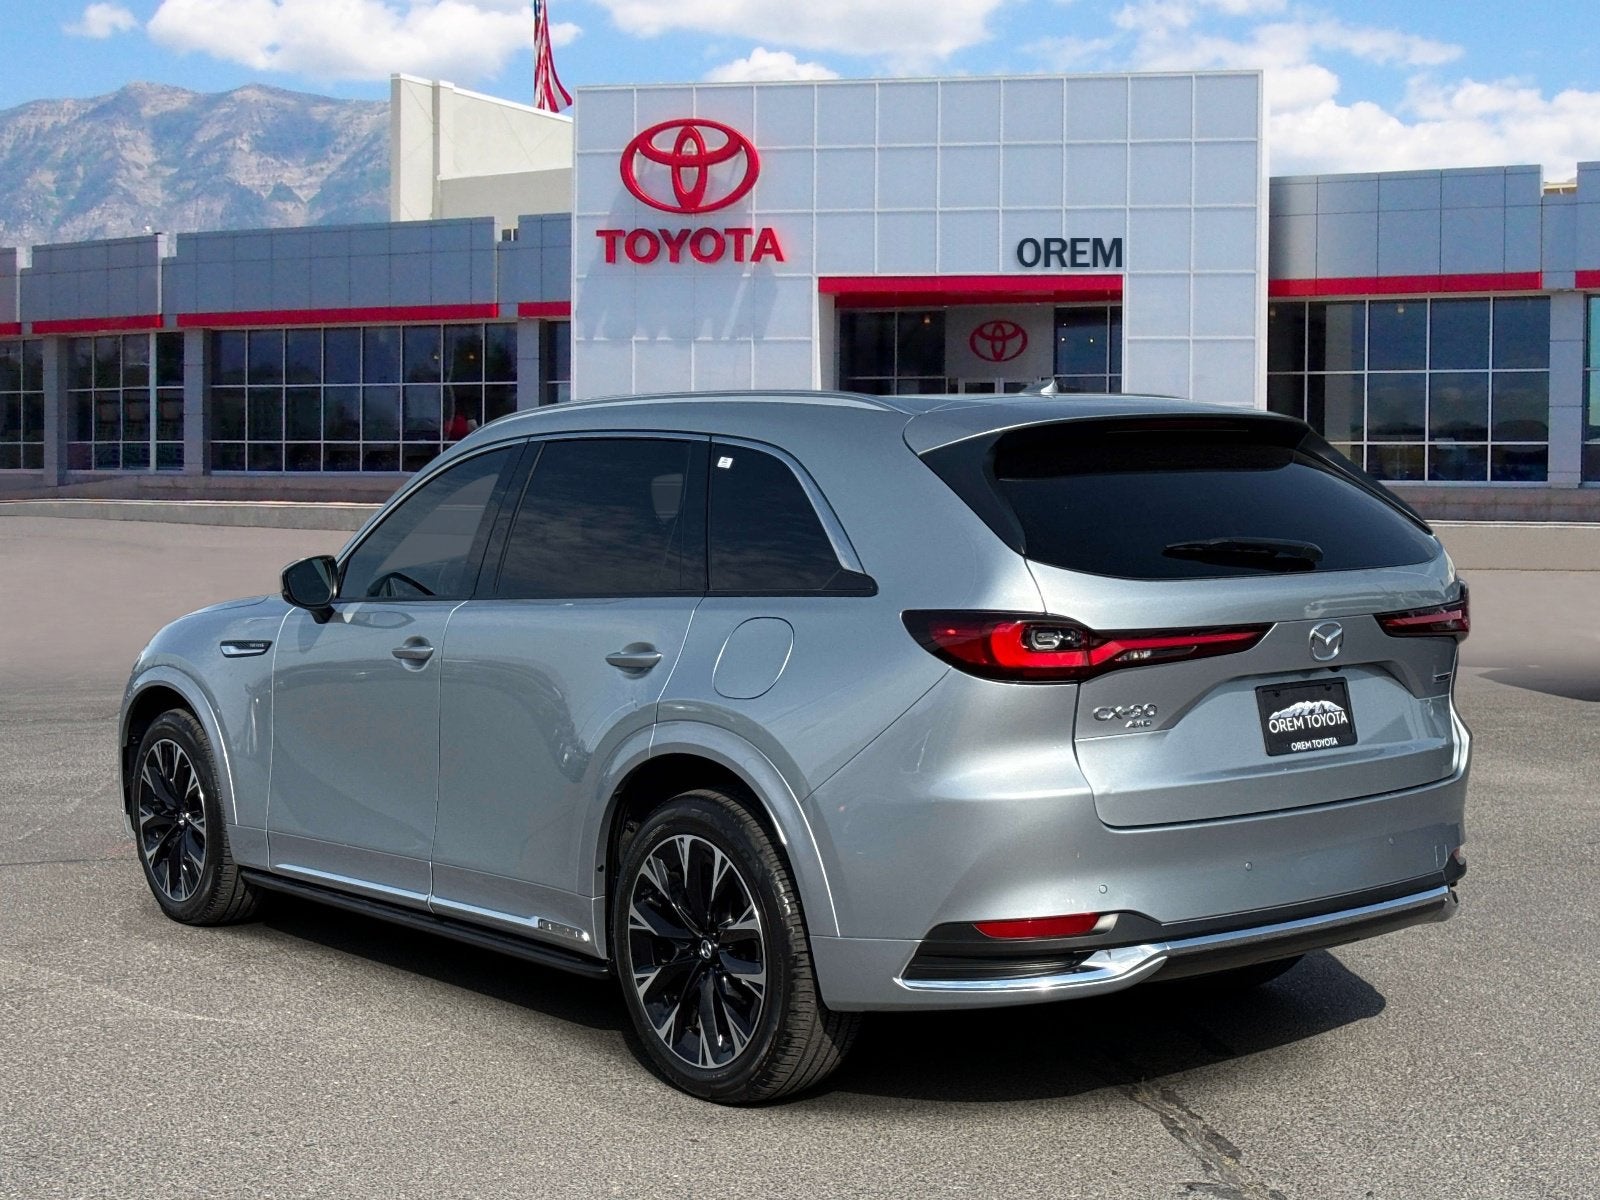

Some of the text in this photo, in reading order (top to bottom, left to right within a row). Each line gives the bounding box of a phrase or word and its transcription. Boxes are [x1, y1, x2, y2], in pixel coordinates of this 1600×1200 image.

[596, 227, 785, 264] TOYOTA
[1017, 237, 1123, 268] OREM
[1268, 711, 1348, 734] OREM TOYOTA
[1291, 737, 1338, 751] OREM TOYOTA
